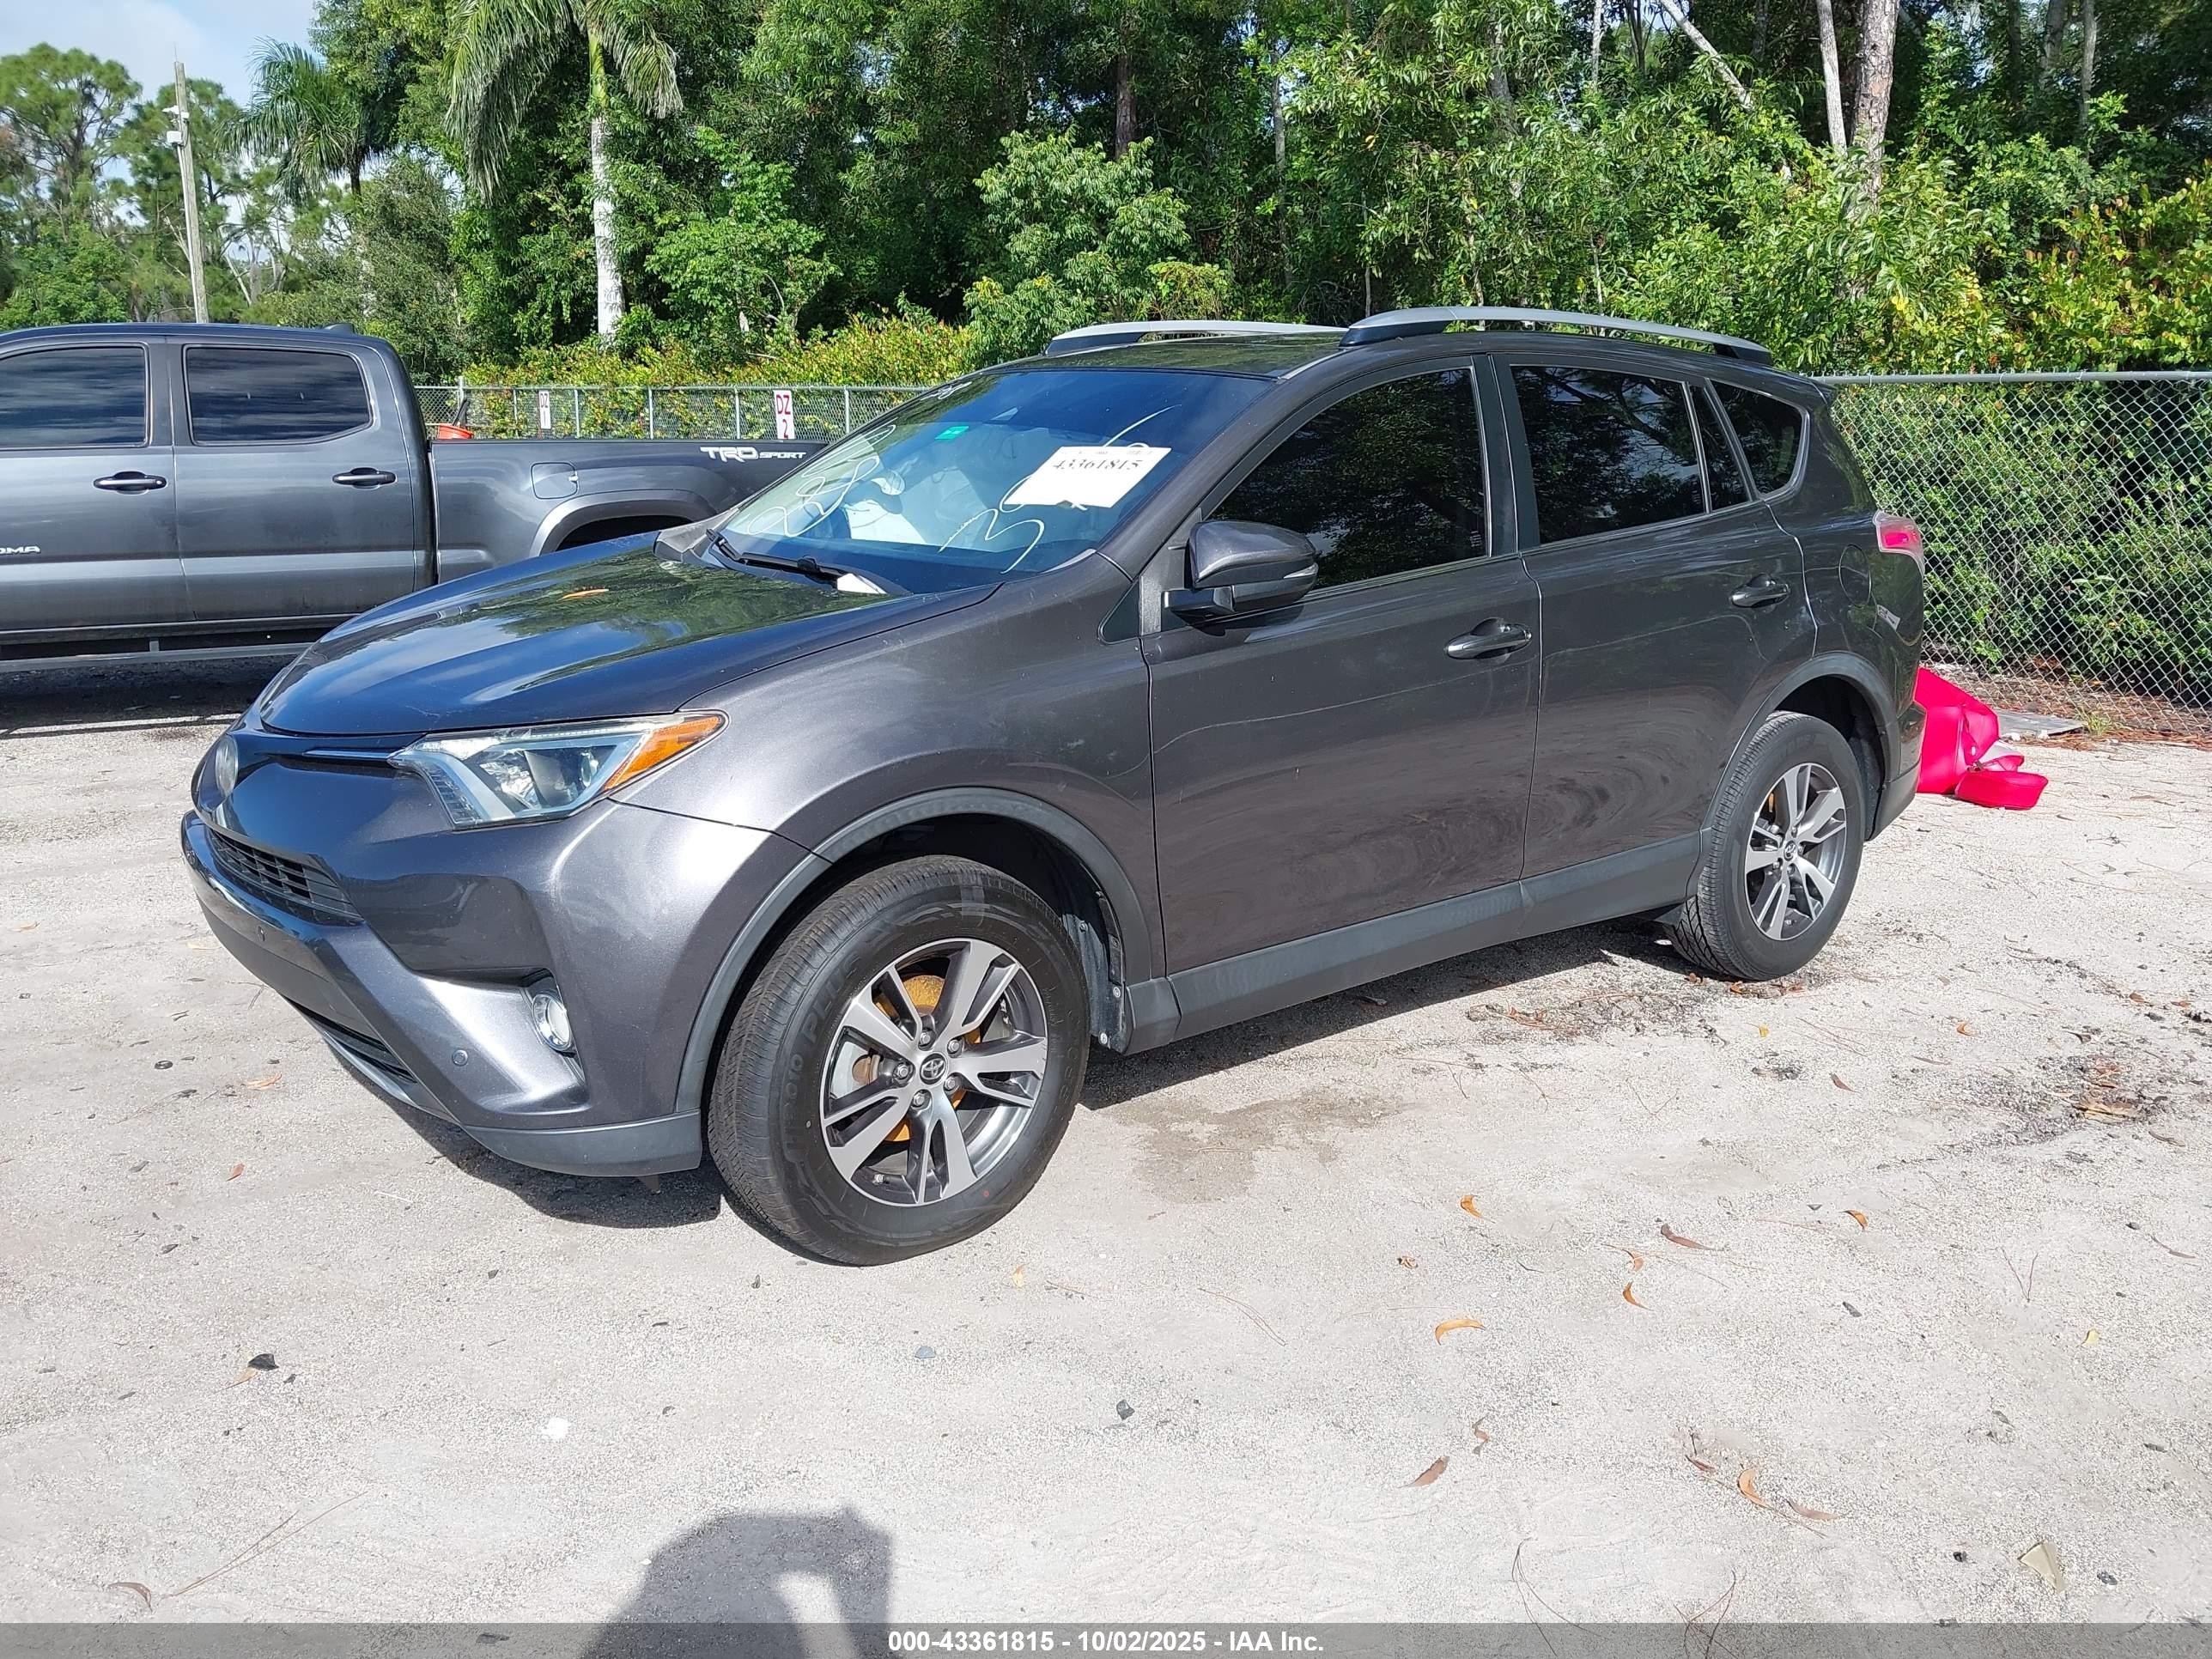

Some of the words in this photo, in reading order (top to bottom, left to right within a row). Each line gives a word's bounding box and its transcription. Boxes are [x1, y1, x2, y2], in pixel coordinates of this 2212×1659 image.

[540, 392, 549, 408] DZ
[776, 394, 791, 415] DZ
[782, 418, 789, 439] 2
[700, 447, 758, 463] TRD
[1053, 459, 1143, 470] 43361815
